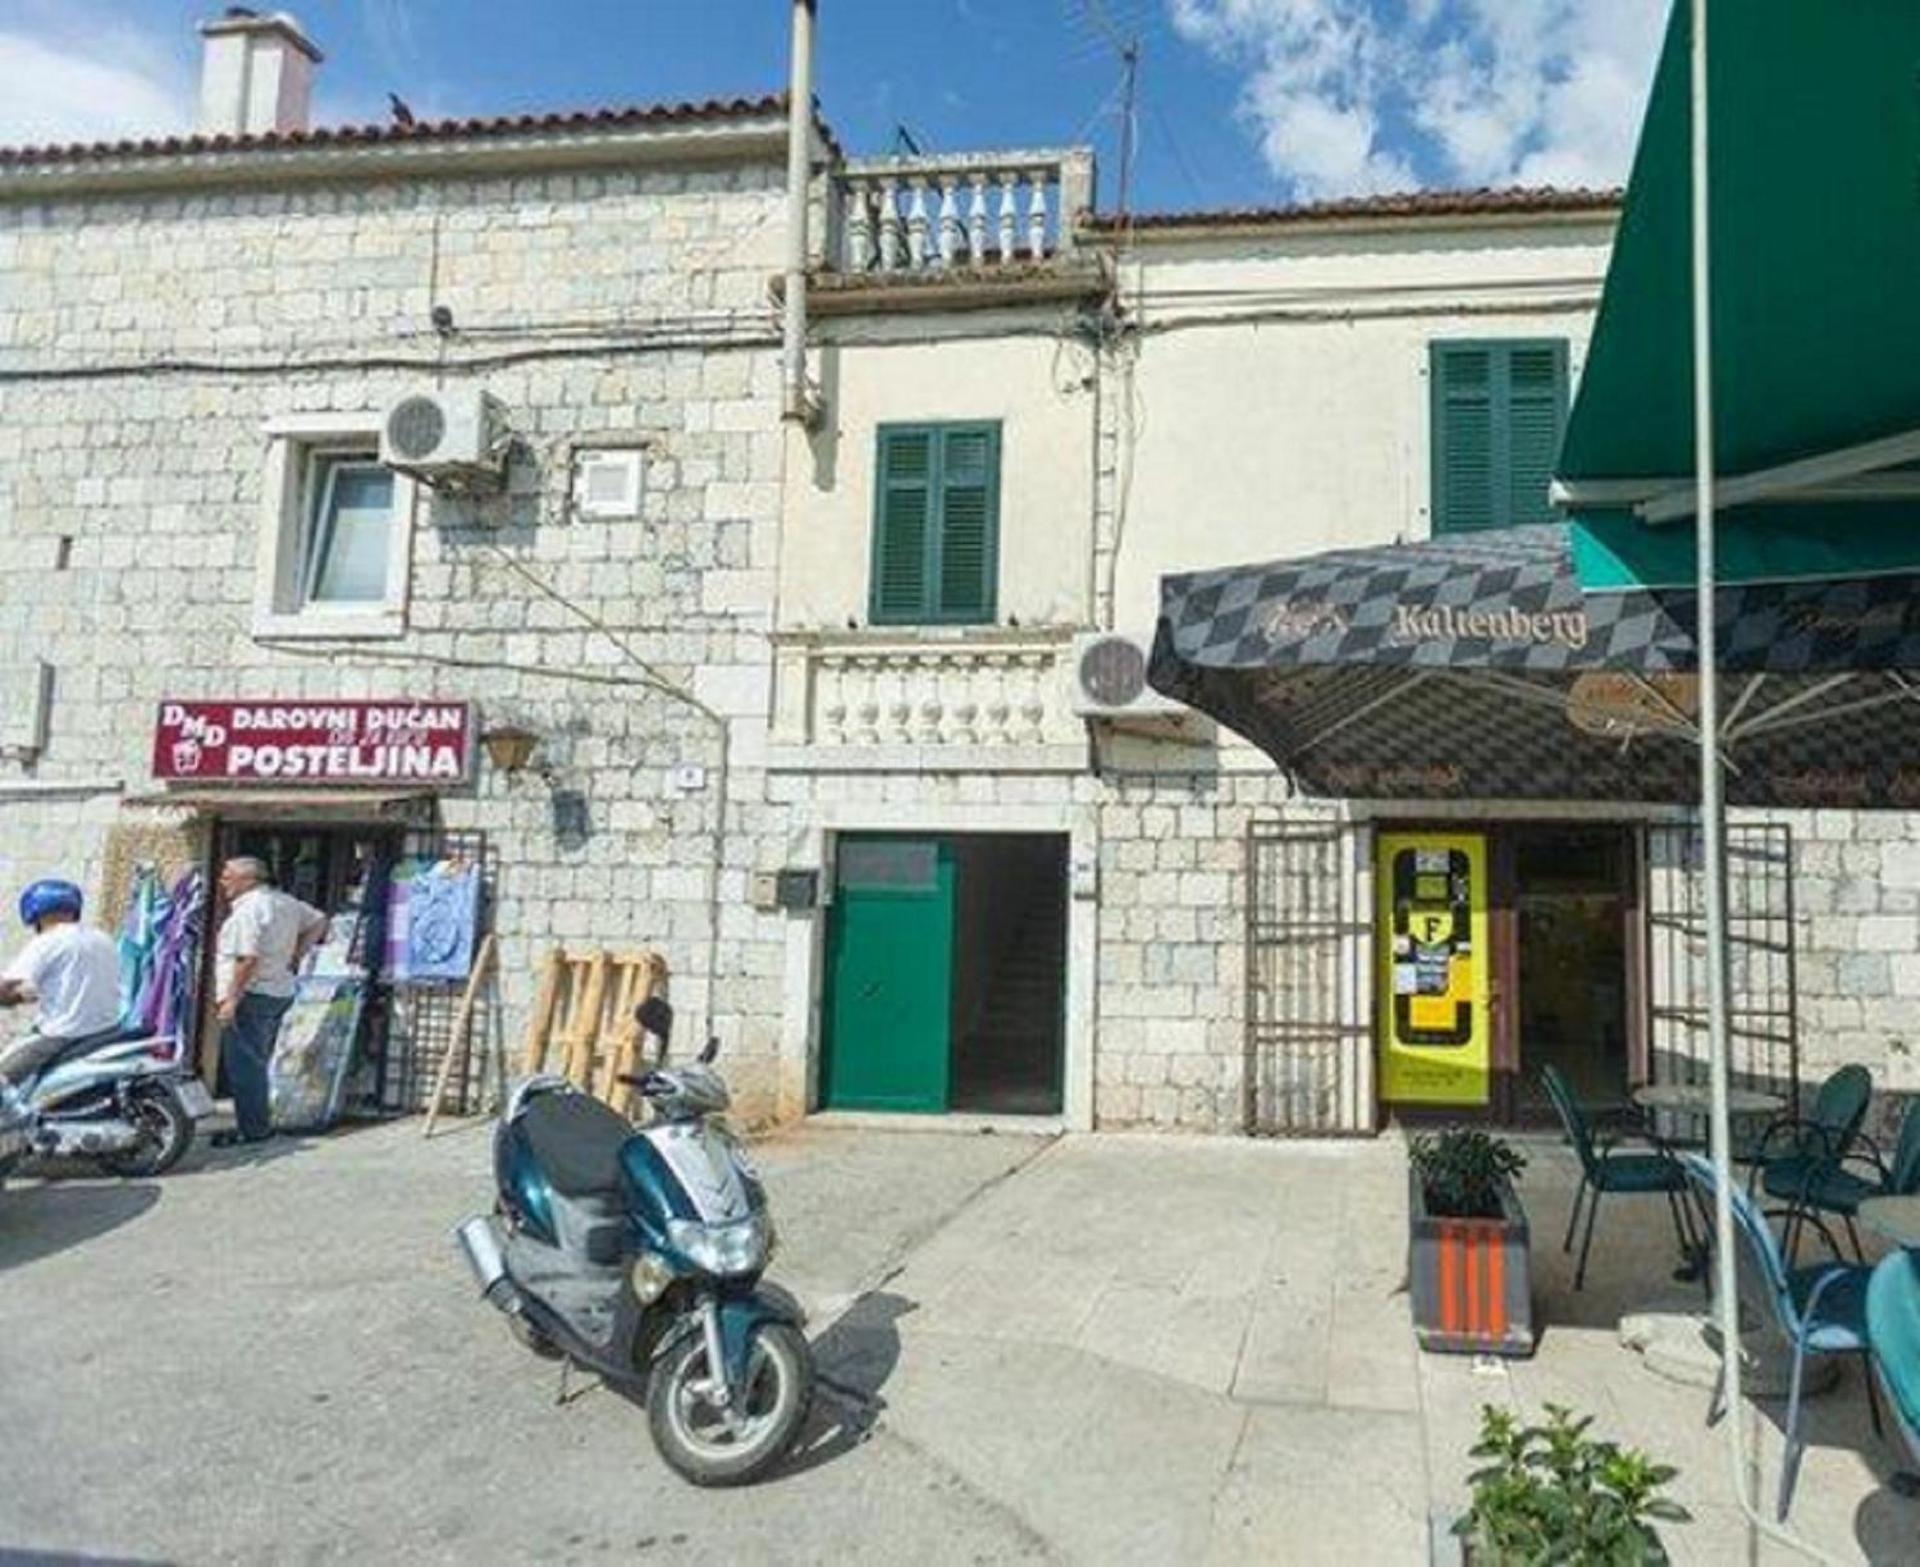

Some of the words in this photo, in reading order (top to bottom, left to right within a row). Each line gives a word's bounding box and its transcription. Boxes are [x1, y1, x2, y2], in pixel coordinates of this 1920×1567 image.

[1390, 604, 1588, 649] Kaltenberg
[231, 707, 357, 730] DAROVNI
[226, 744, 460, 776] POSTELJINA
